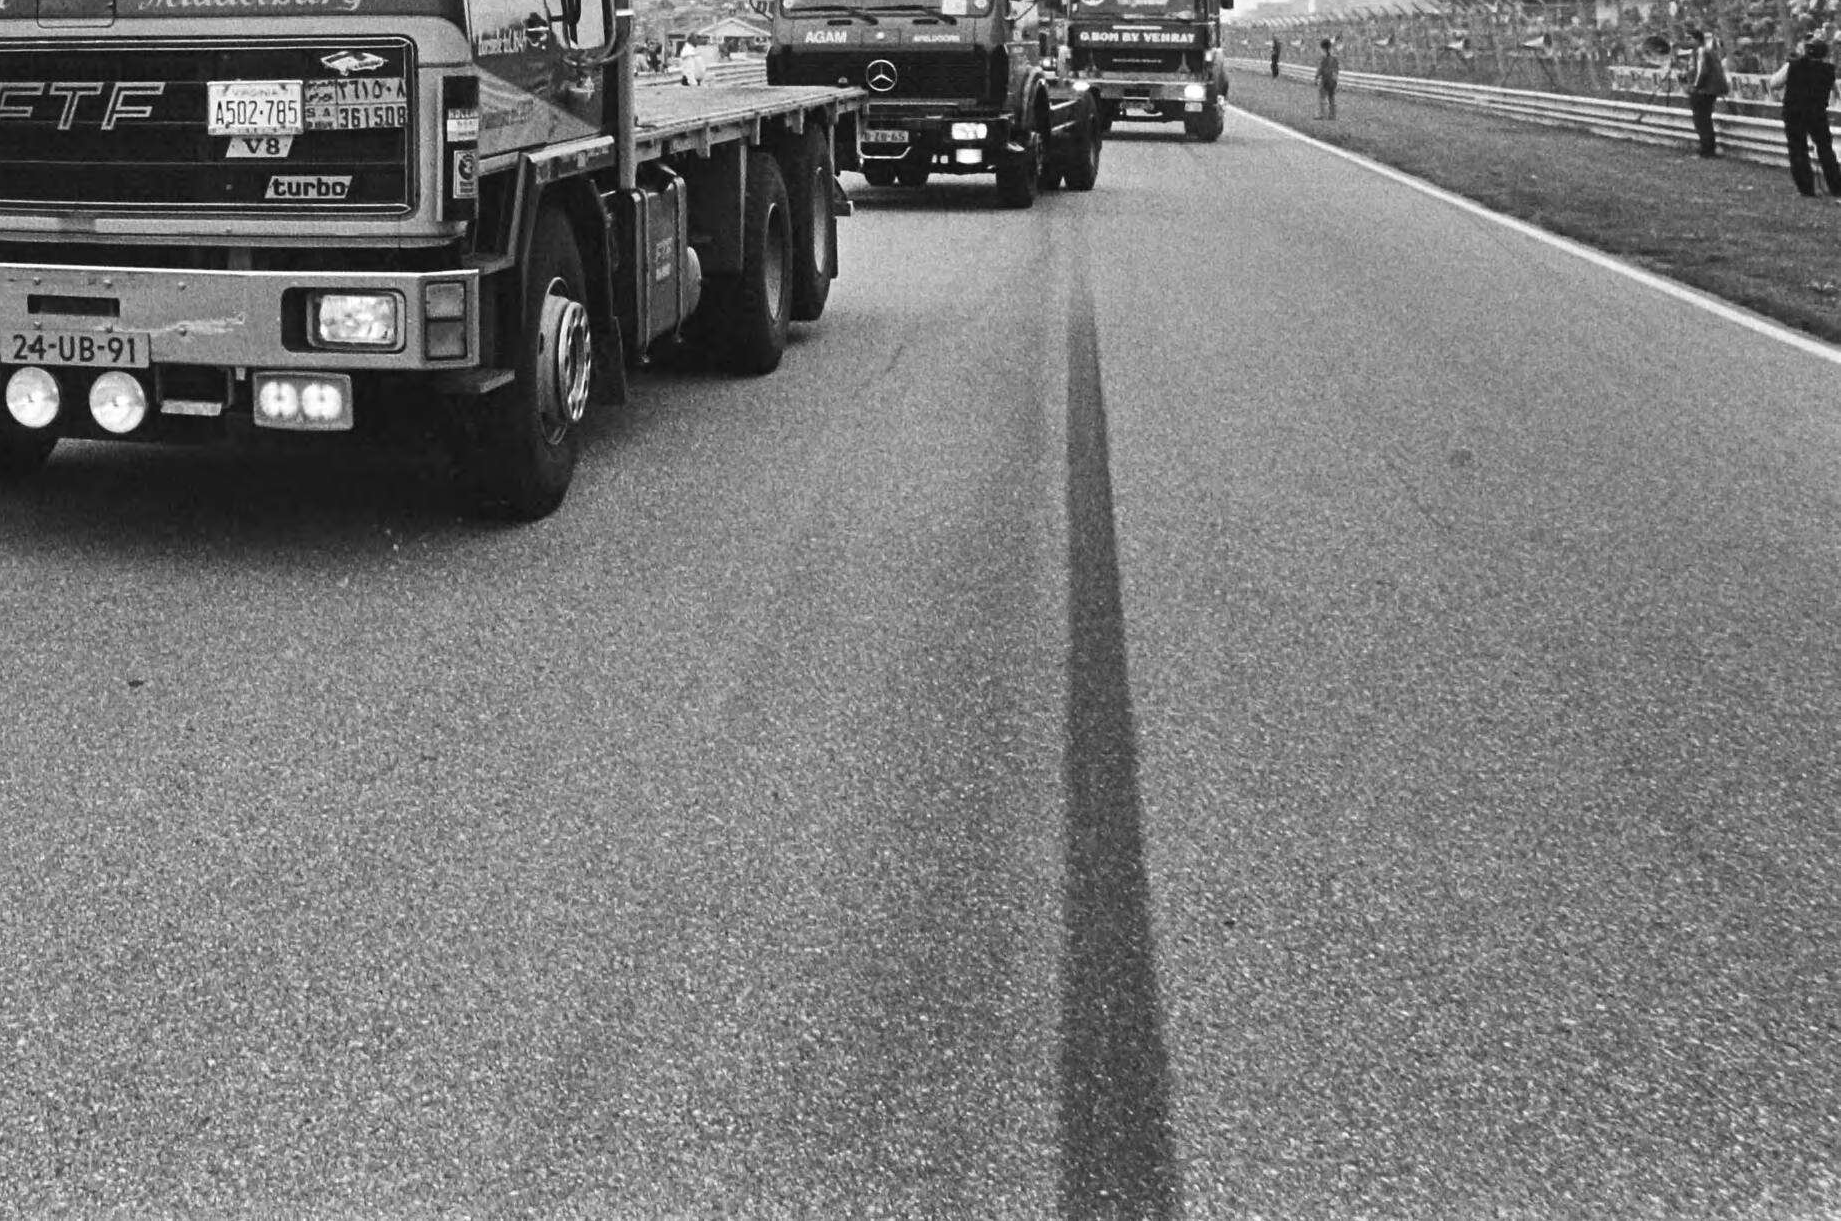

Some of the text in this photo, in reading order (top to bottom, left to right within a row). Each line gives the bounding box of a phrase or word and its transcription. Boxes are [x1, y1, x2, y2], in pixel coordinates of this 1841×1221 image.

[805, 30, 848, 44] AGAM
[339, 105, 407, 128] 361508
[242, 137, 281, 155] V8
[271, 177, 348, 198] turbo
[11, 333, 138, 364] 24-UB-91
